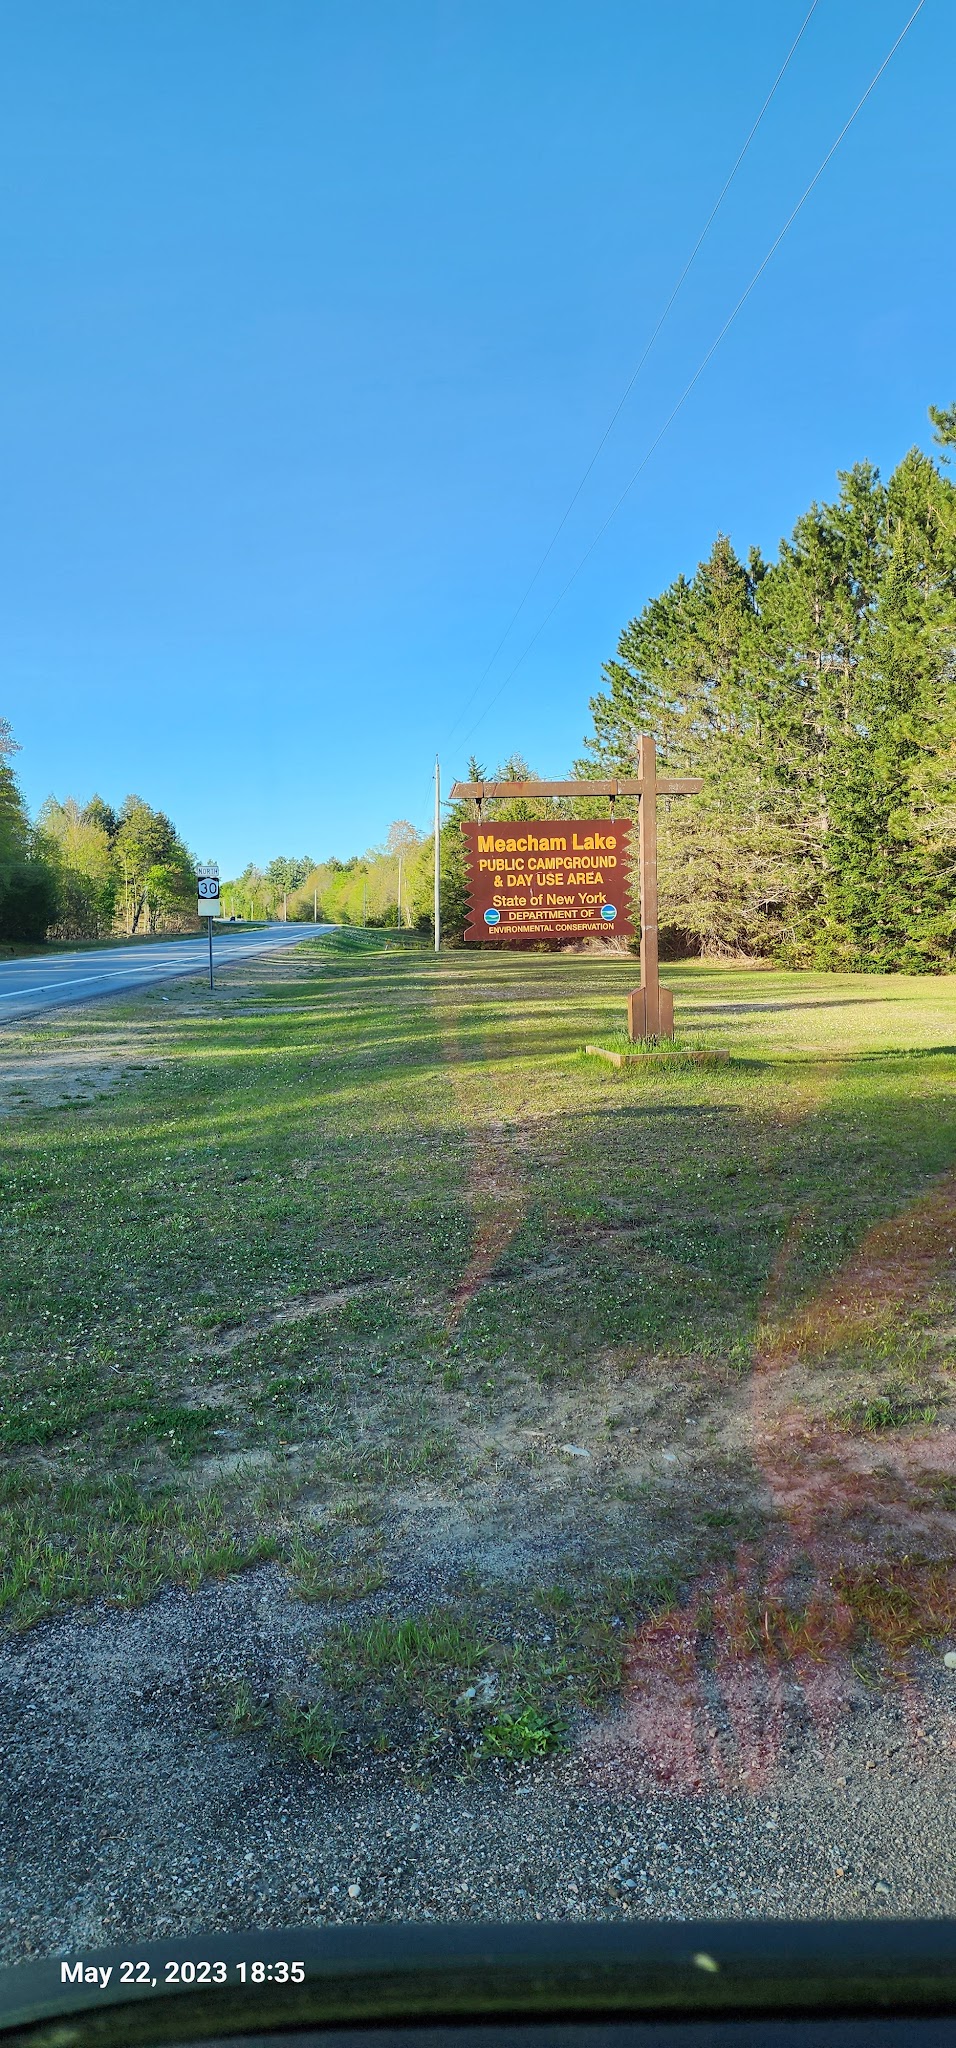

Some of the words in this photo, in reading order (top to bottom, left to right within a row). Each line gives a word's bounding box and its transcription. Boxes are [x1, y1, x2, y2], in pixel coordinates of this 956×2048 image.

[478, 835, 566, 852] Meacham
[573, 833, 616, 850] Lake
[480, 858, 524, 871] PUBLIC
[528, 856, 617, 870] CAMPGROUND
[494, 875, 503, 887] &
[507, 874, 533, 886] DAY
[537, 874, 564, 885] USE
[567, 872, 603, 884] AREA
[201, 883, 217, 894] 30
[493, 895, 526, 907] State
[530, 894, 543, 905] of
[547, 894, 575, 905] New
[578, 892, 607, 904] York
[509, 910, 578, 920] DEPARTMENT
[580, 910, 594, 918] OF
[489, 925, 554, 934] ENVIRONMENTAL
[556, 923, 614, 931] CONSERVATION
